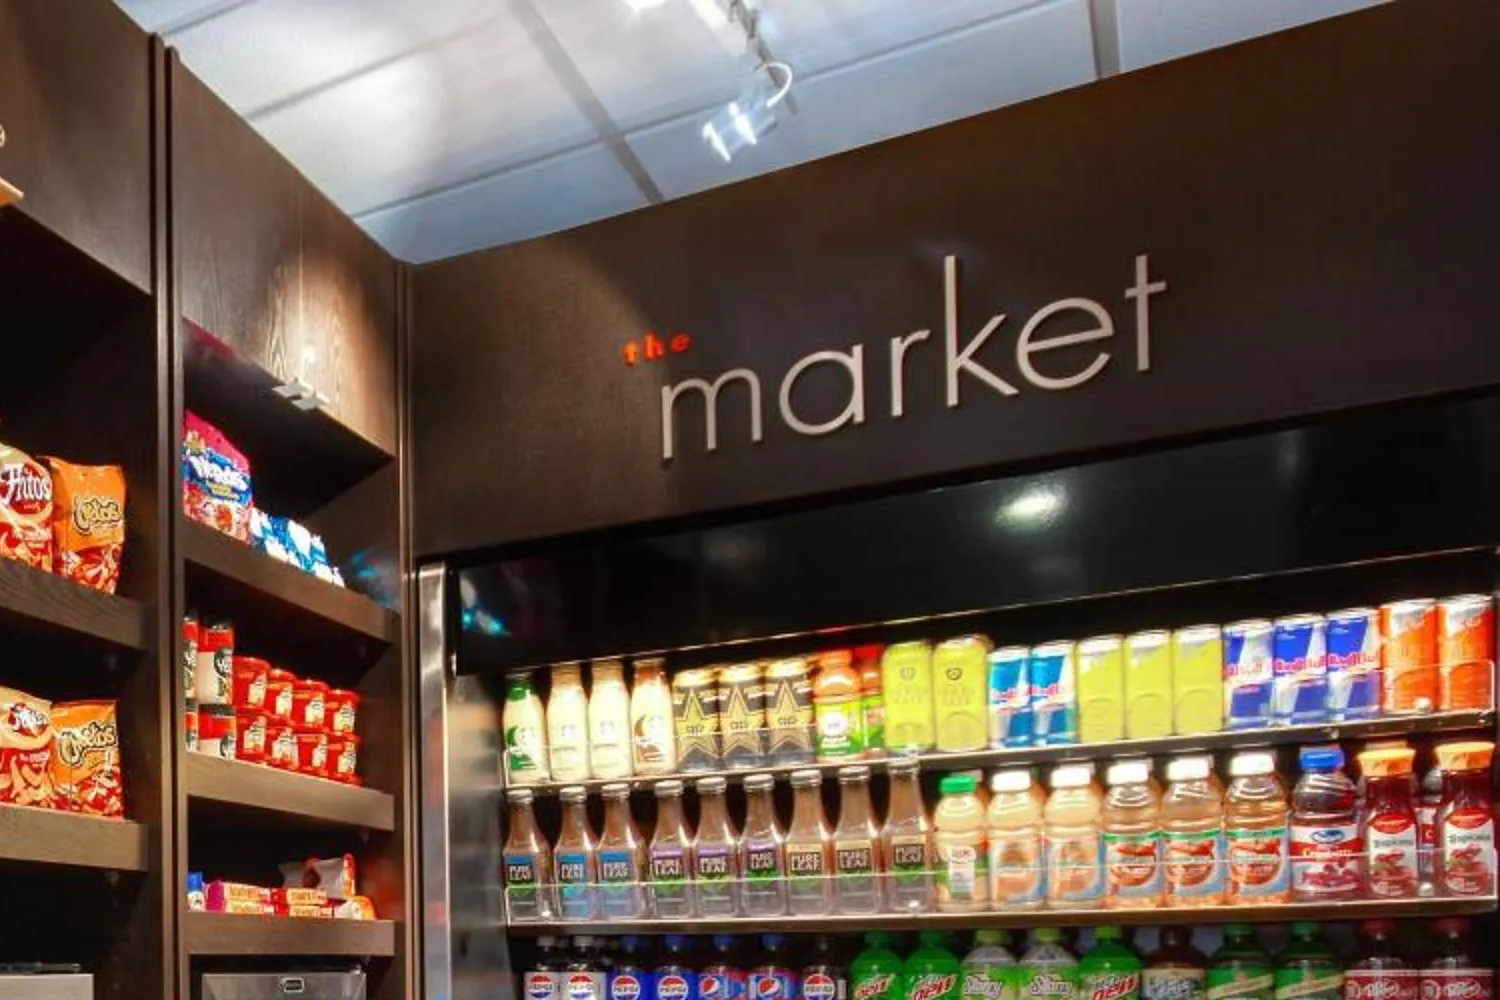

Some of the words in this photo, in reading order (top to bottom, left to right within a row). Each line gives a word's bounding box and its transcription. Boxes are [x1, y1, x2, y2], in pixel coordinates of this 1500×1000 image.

[622, 330, 692, 367] the
[661, 254, 1168, 463] market
[0, 464, 51, 506] Fritos
